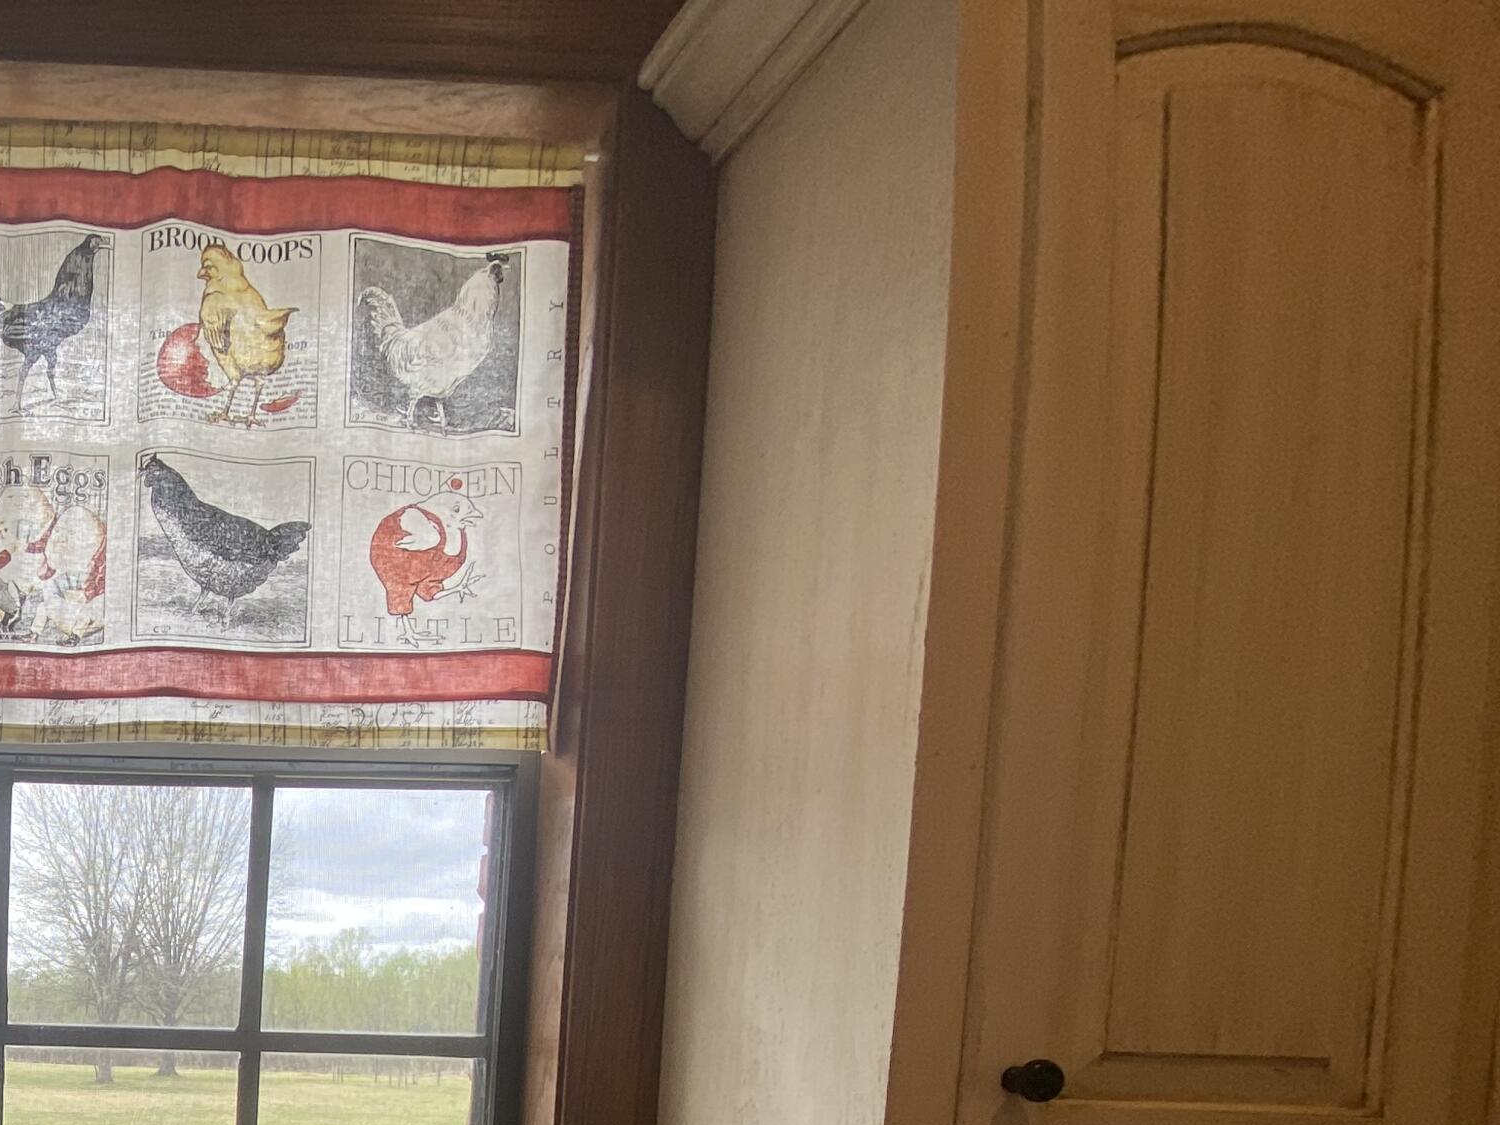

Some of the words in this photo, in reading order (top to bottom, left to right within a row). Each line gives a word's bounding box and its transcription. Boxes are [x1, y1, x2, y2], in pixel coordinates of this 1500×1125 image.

[237, 238, 314, 264] COOPS
[29, 453, 107, 504] Eggs
[346, 460, 520, 498] CHICKEN
[342, 615, 517, 646] LITTLE
